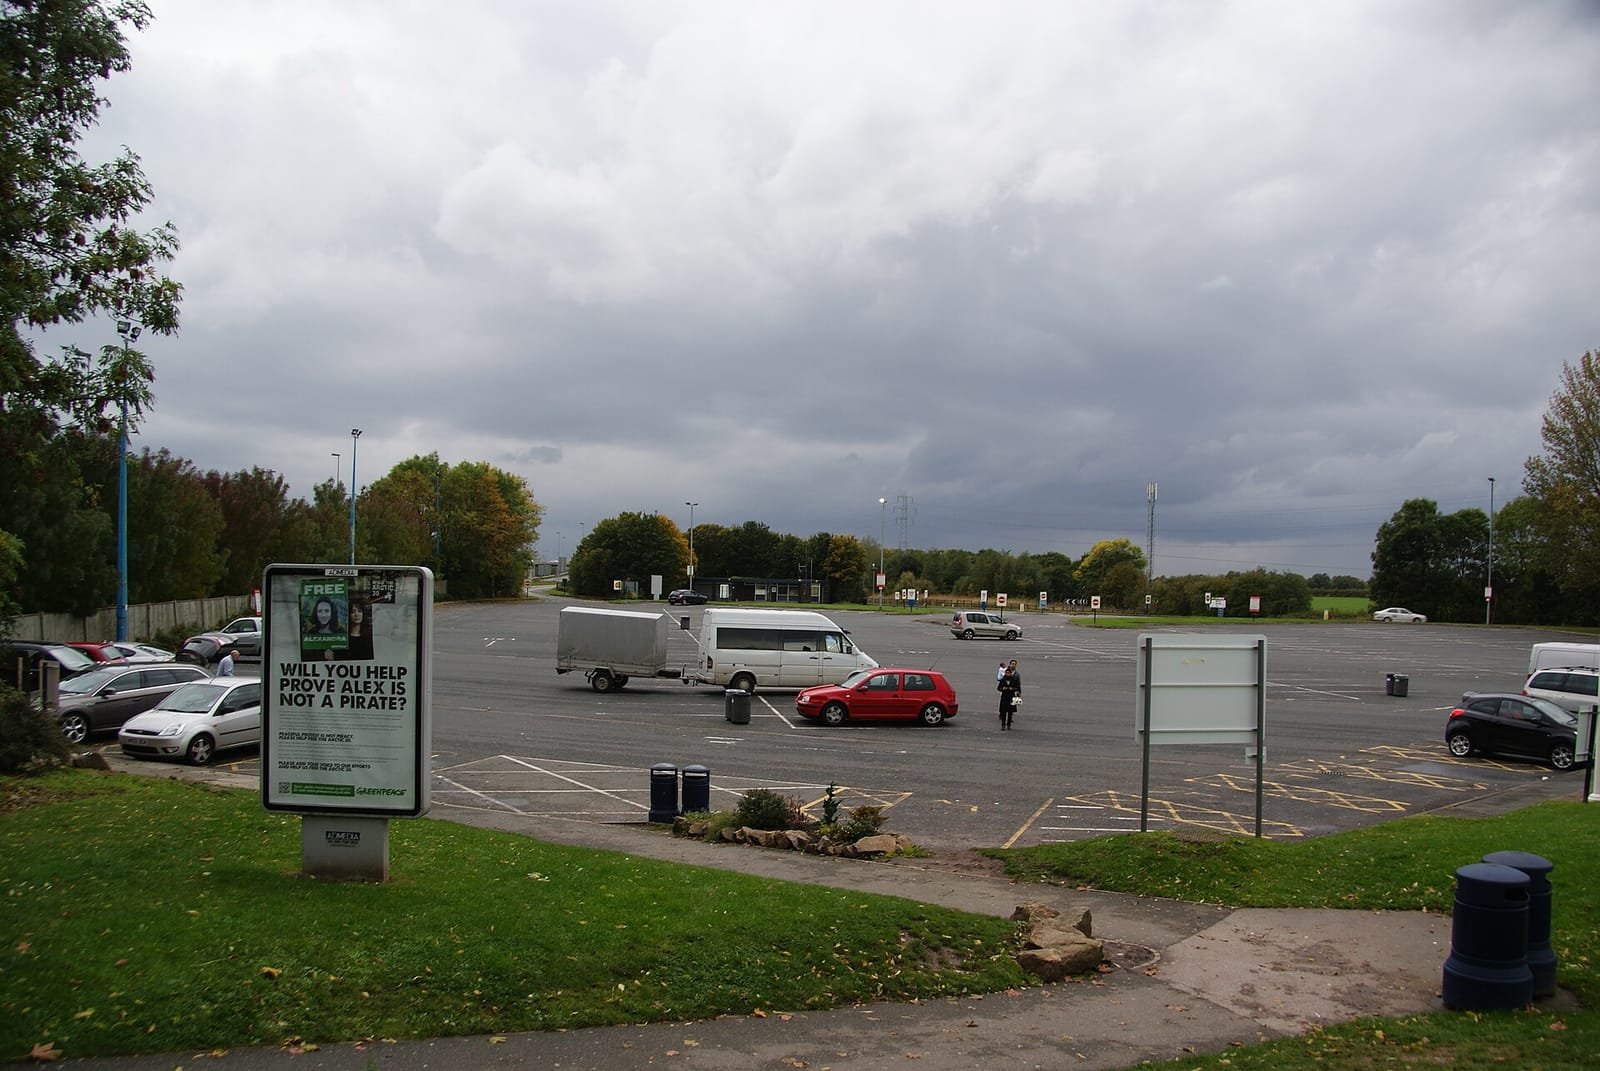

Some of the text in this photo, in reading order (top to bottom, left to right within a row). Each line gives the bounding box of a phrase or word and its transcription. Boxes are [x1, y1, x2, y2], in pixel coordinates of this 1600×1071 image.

[304, 583, 345, 595] FREE
[280, 663, 408, 680] WILL YOU HELP
[280, 678, 406, 695] PROVE ALEX IS
[280, 693, 407, 710] NOT A PIRATE?
[356, 787, 407, 796] GREENPEACE
